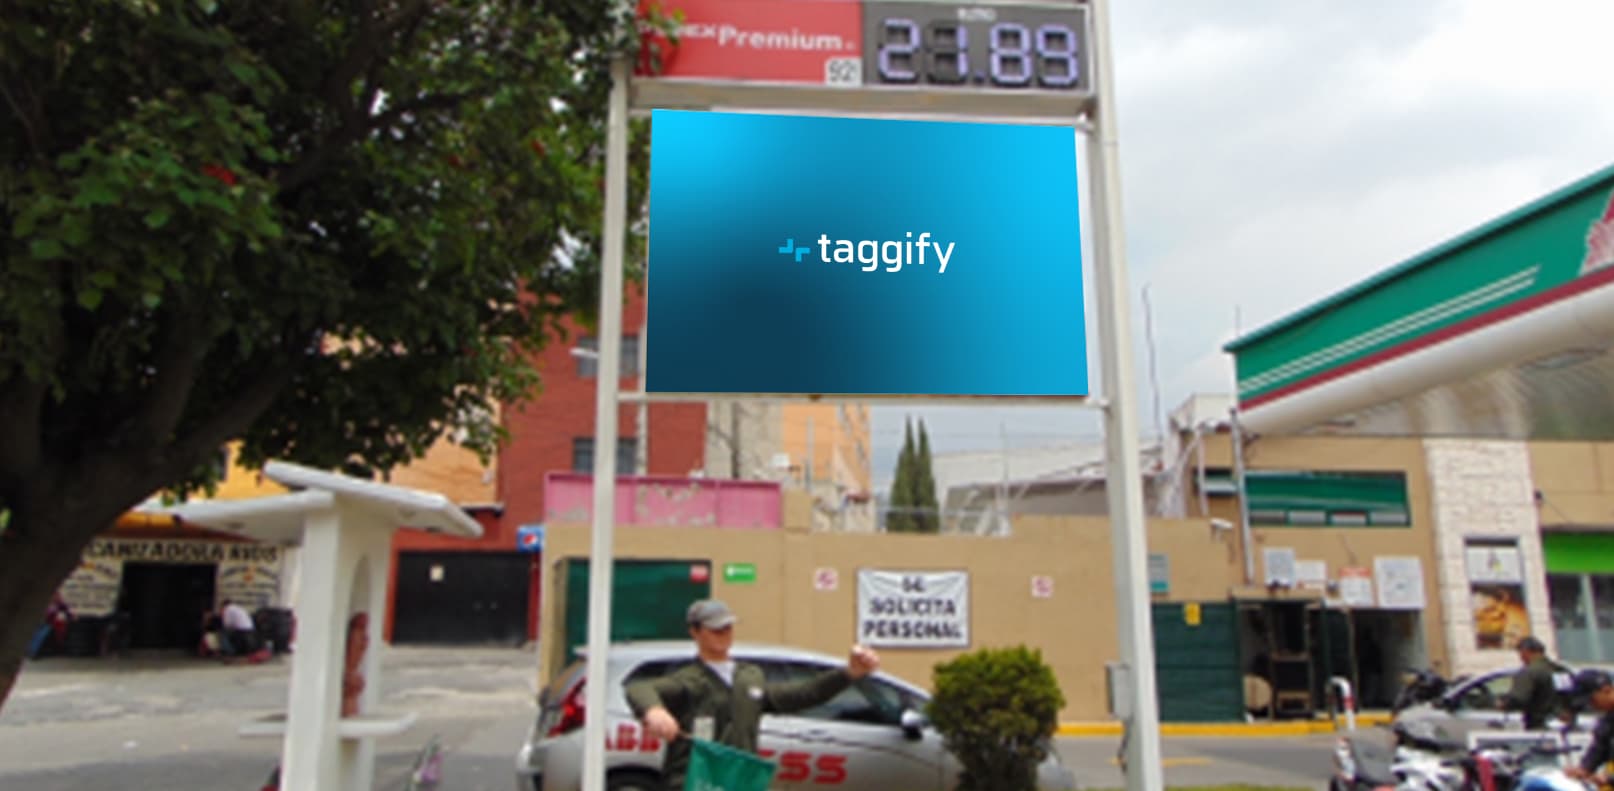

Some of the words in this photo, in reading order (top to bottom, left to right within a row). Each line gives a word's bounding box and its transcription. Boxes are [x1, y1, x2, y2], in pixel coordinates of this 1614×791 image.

[718, 24, 843, 51] Premium
[878, 17, 1077, 85] 21.89
[817, 231, 956, 274] taggify
[902, 576, 926, 593] SE
[869, 596, 955, 616] SOLICITA
[863, 620, 962, 639] PERSONAL
